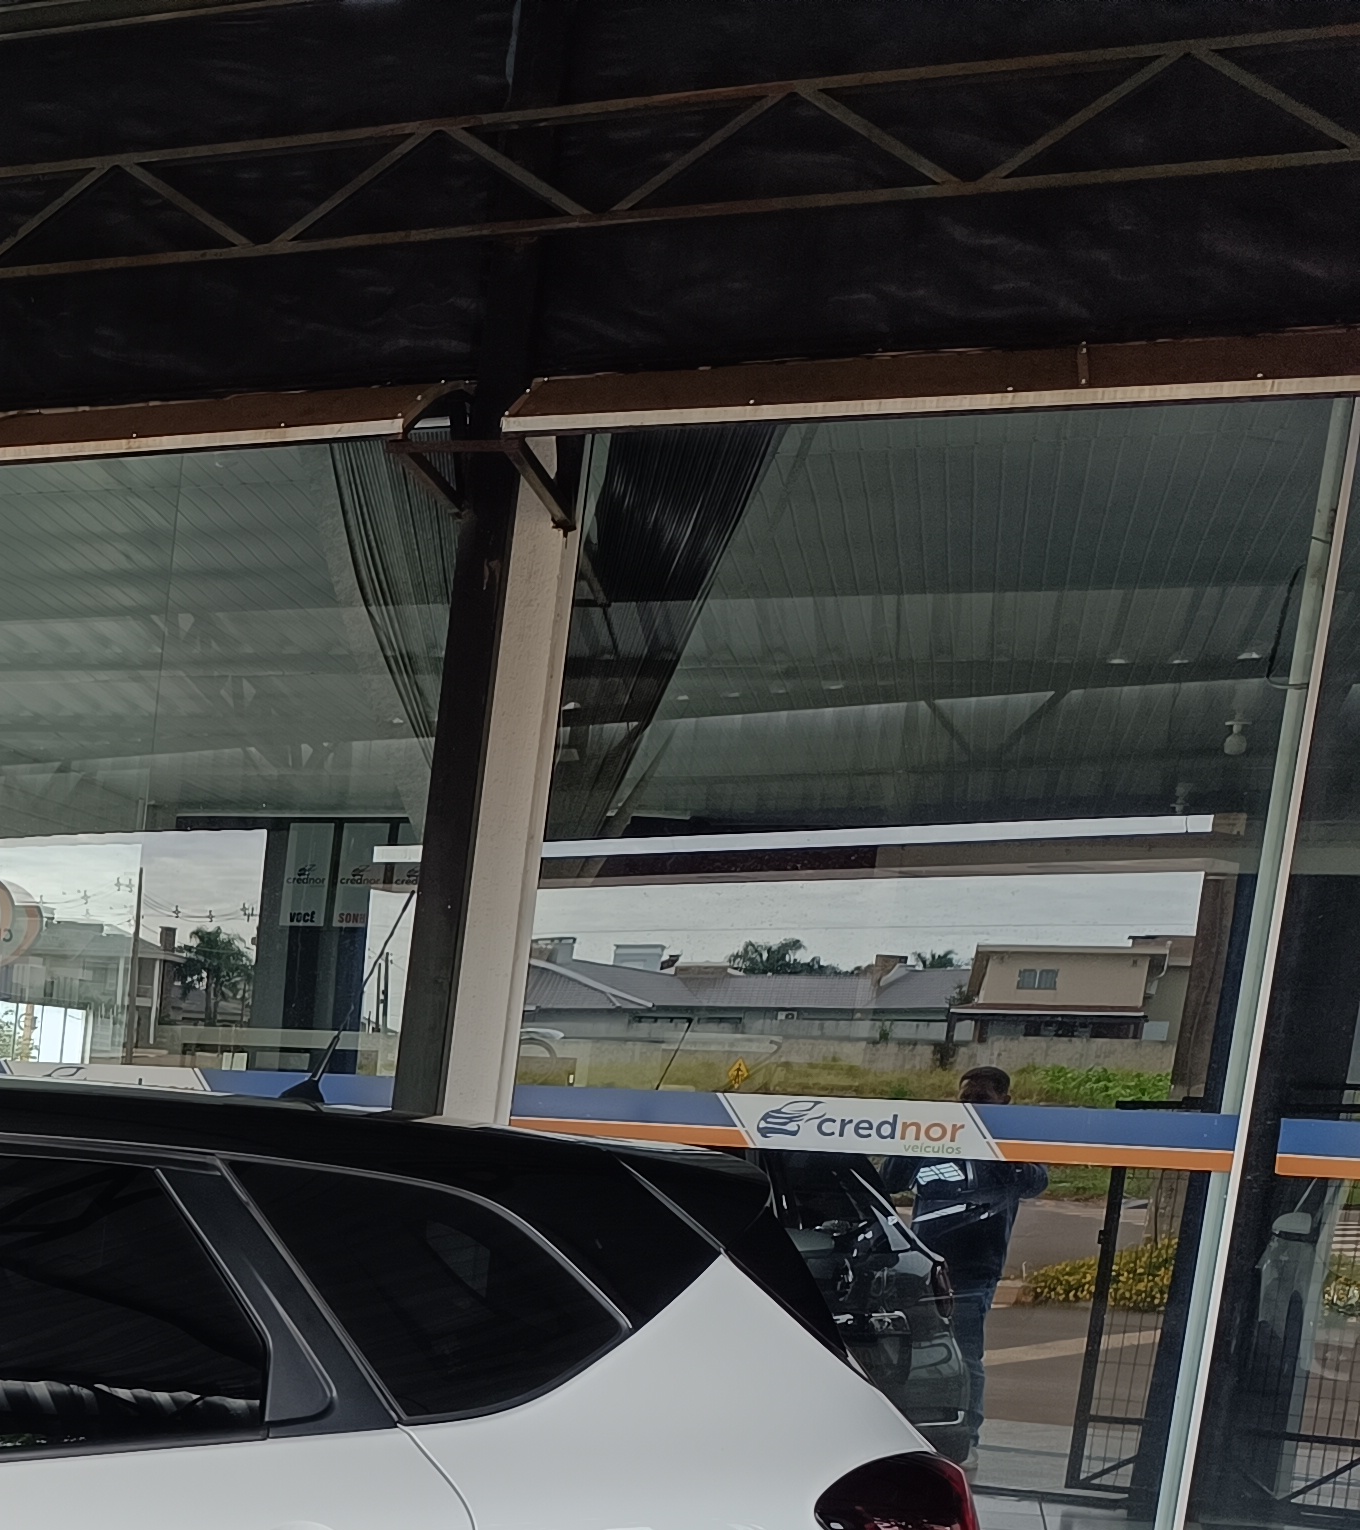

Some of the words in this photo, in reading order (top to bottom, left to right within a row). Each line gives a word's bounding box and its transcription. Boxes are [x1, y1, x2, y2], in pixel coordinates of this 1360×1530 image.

[395, 877, 418, 885] cred
[817, 1114, 965, 1143] crednor
[903, 1142, 962, 1155] veículos
